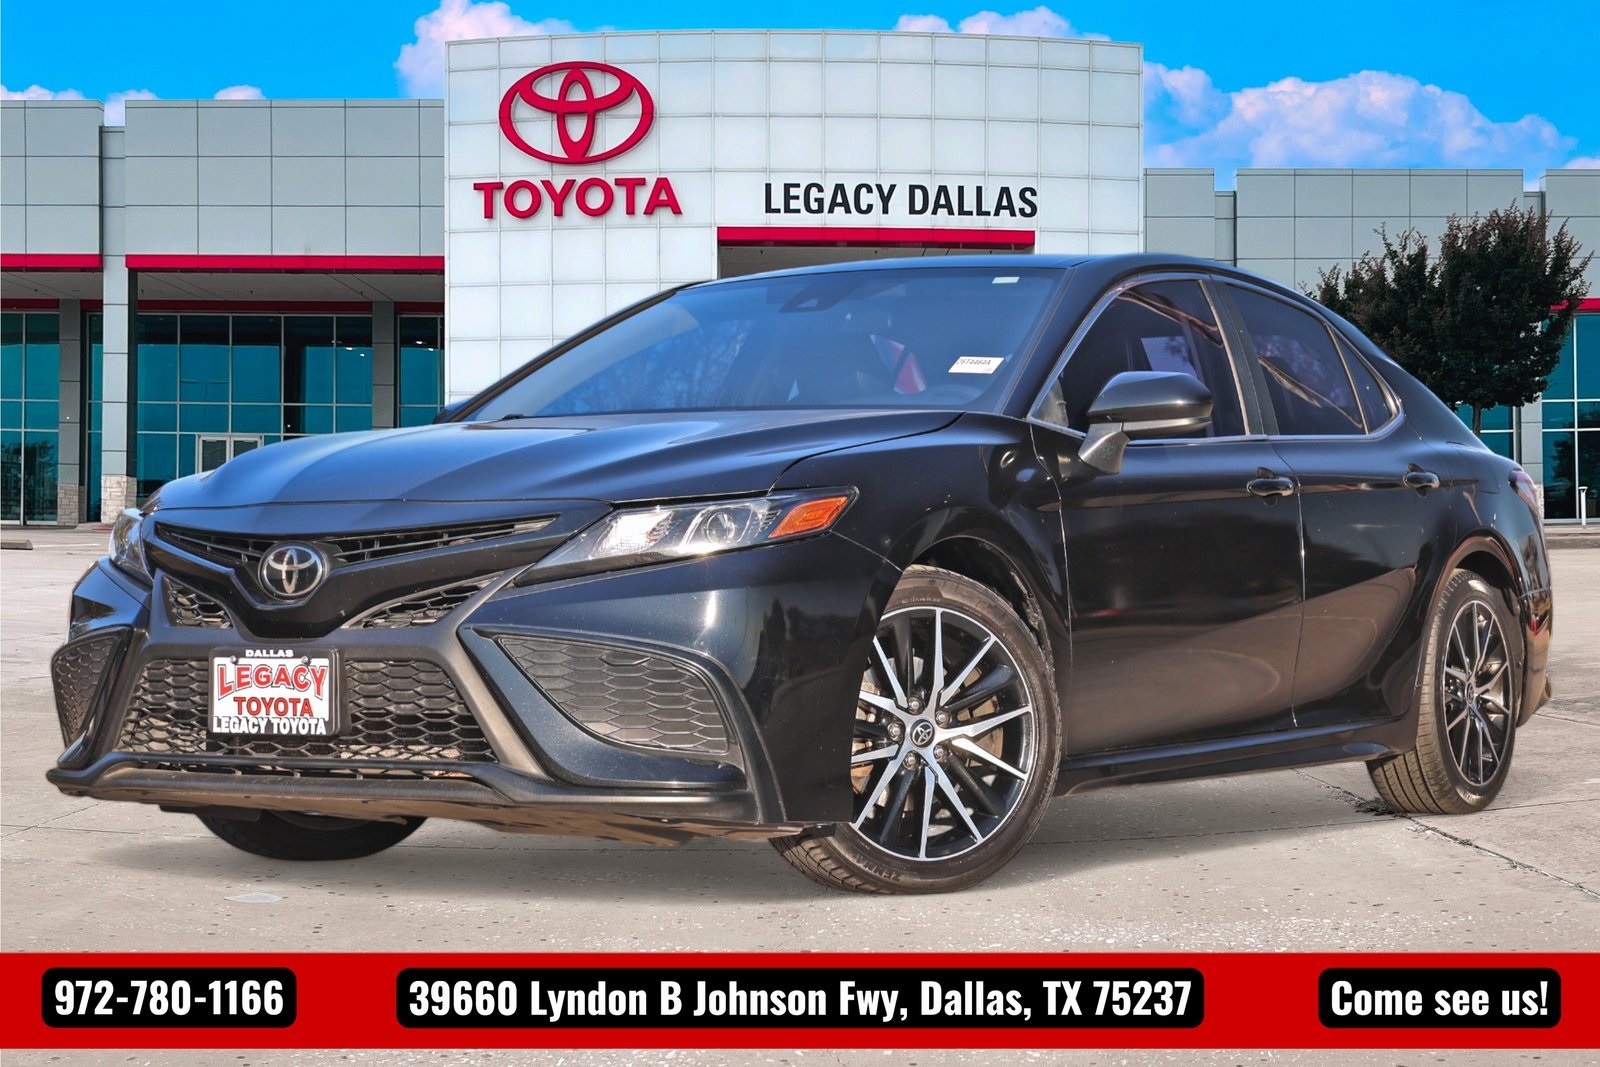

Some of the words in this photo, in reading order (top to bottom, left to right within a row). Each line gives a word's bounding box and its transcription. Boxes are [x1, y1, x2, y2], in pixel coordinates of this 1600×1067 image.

[474, 177, 682, 220] TOYOTA
[764, 182, 897, 215] LEGACY
[908, 184, 1038, 218] DALLAS
[245, 649, 294, 658] DALLAS
[217, 663, 329, 701] LEGACY
[233, 696, 314, 717] TOYOTA
[212, 715, 268, 735] LEGACY
[271, 716, 327, 735] TOYOTA
